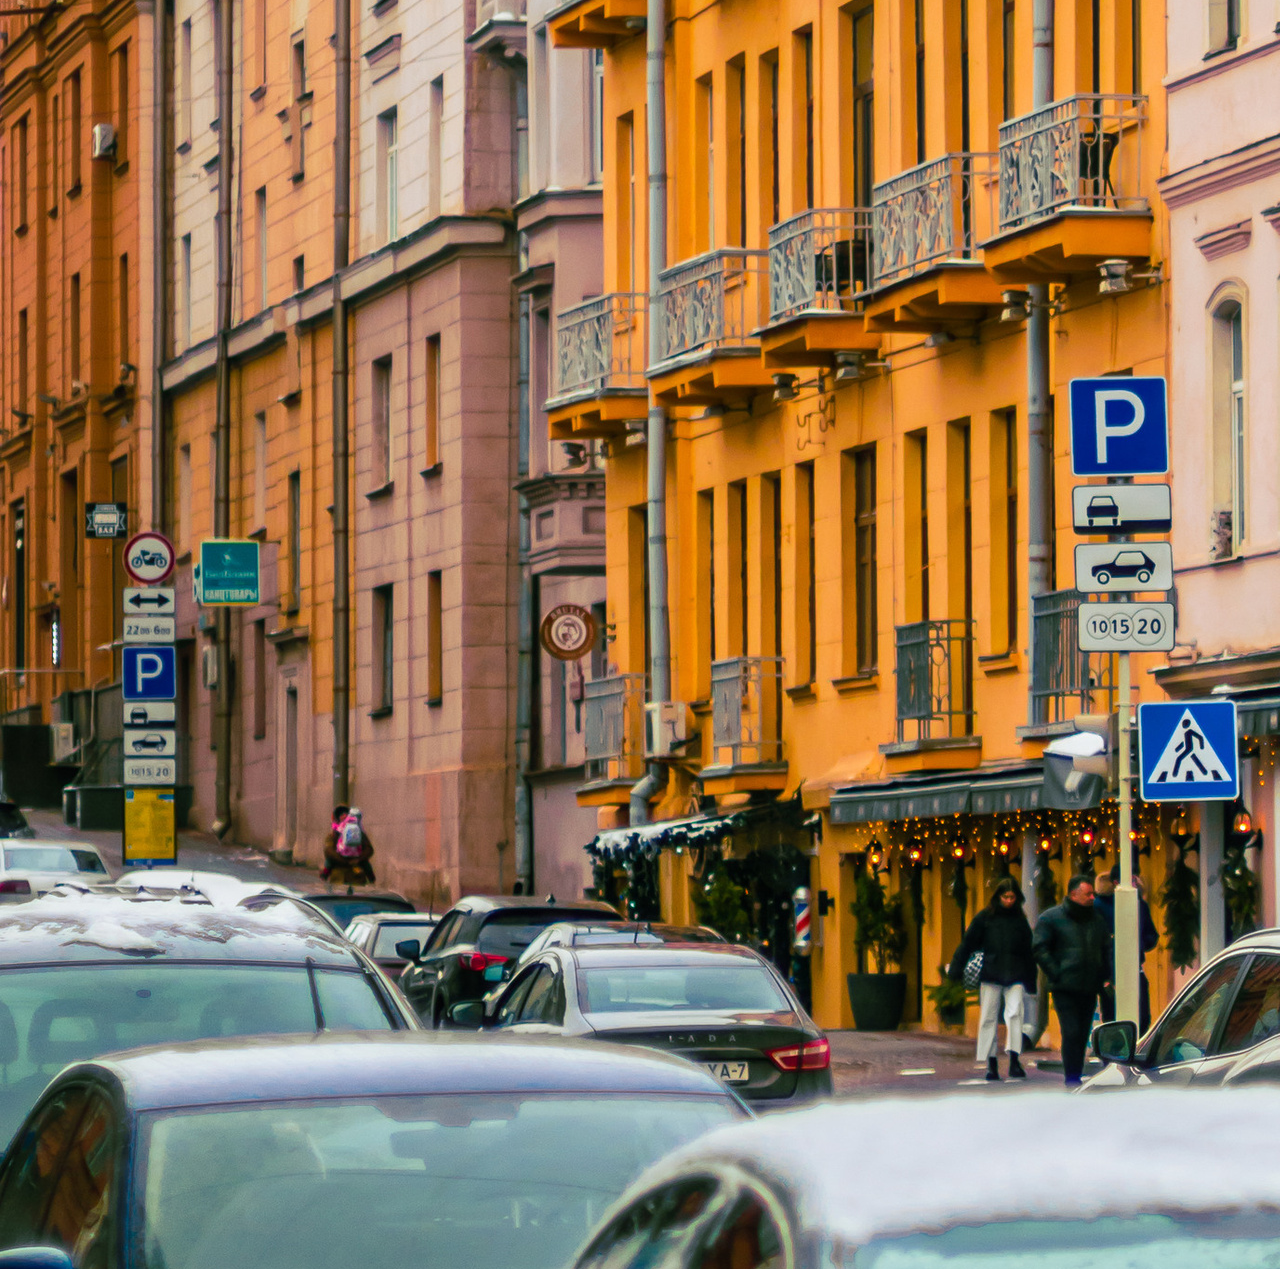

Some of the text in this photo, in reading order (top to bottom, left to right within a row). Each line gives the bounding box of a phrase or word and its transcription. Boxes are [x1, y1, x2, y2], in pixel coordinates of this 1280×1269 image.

[1095, 390, 1145, 463] P
[1092, 618, 1162, 634] 10 15 20
[137, 653, 163, 692] P
[156, 767, 169, 777] 20
[668, 1034, 737, 1043] LADA
